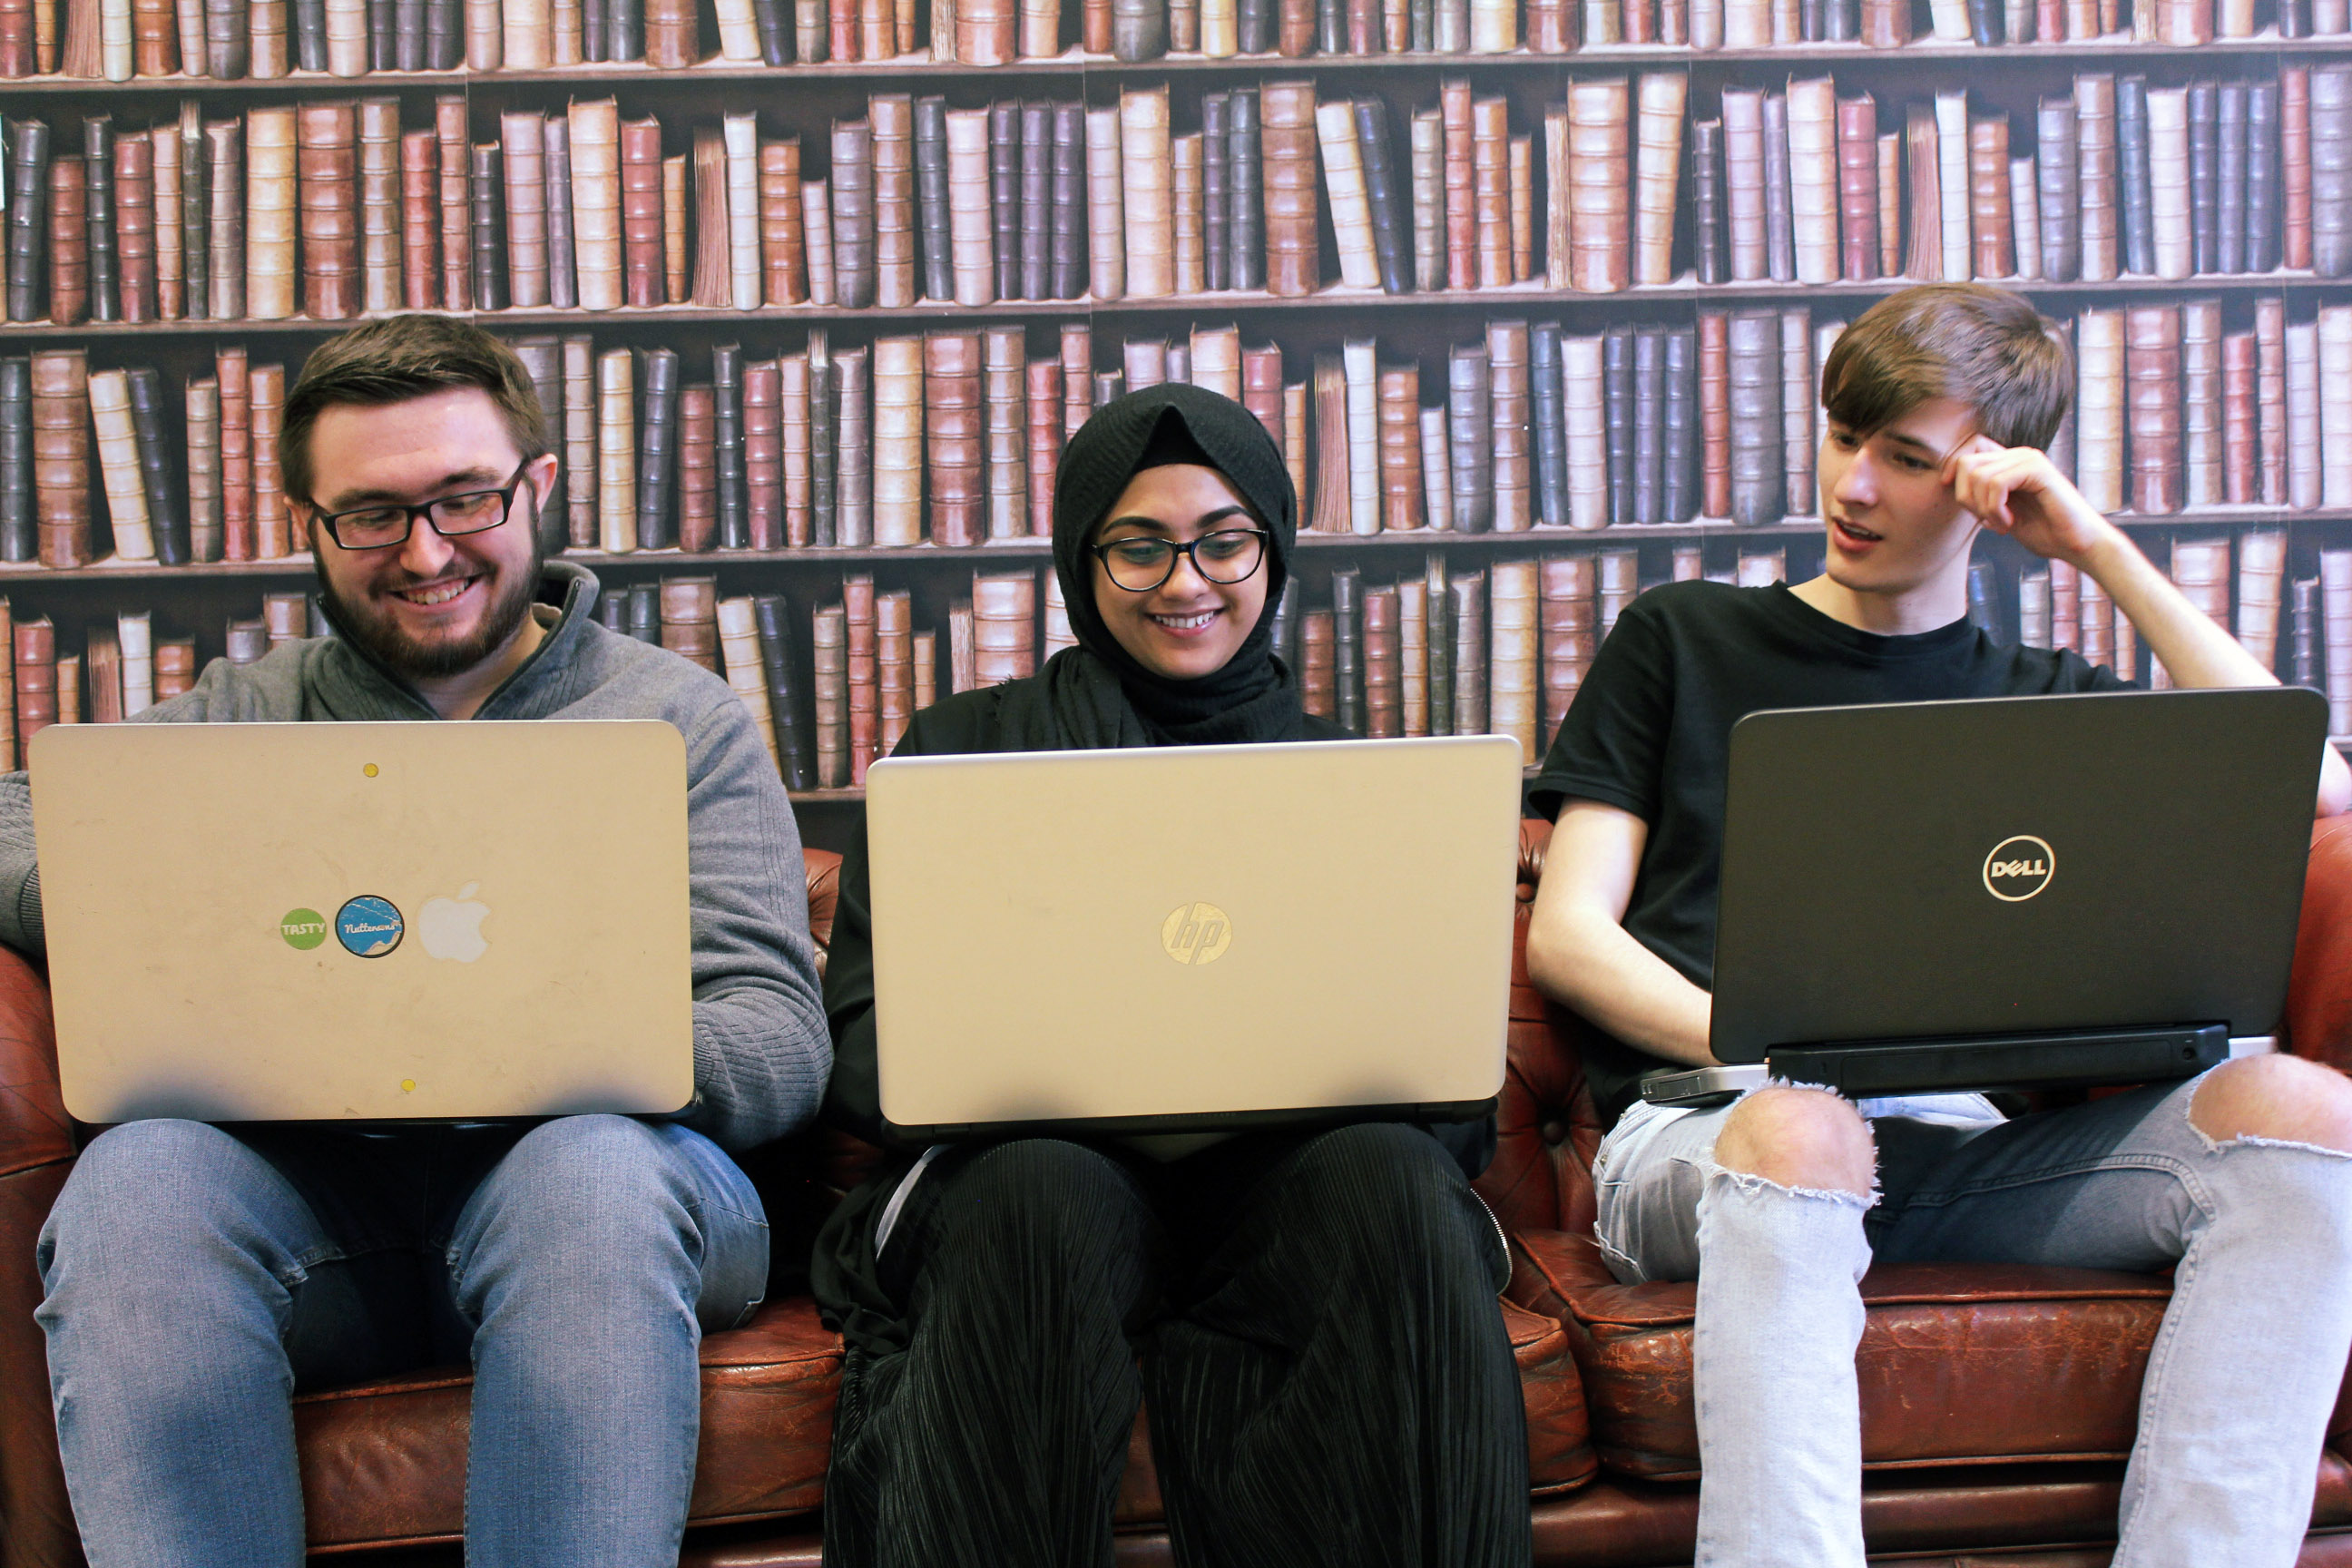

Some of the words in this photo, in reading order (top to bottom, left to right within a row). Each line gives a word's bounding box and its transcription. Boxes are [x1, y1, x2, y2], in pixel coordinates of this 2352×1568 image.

[1991, 859, 2047, 877] DELL
[281, 922, 326, 935] TASTY
[1171, 902, 1225, 965] hp
